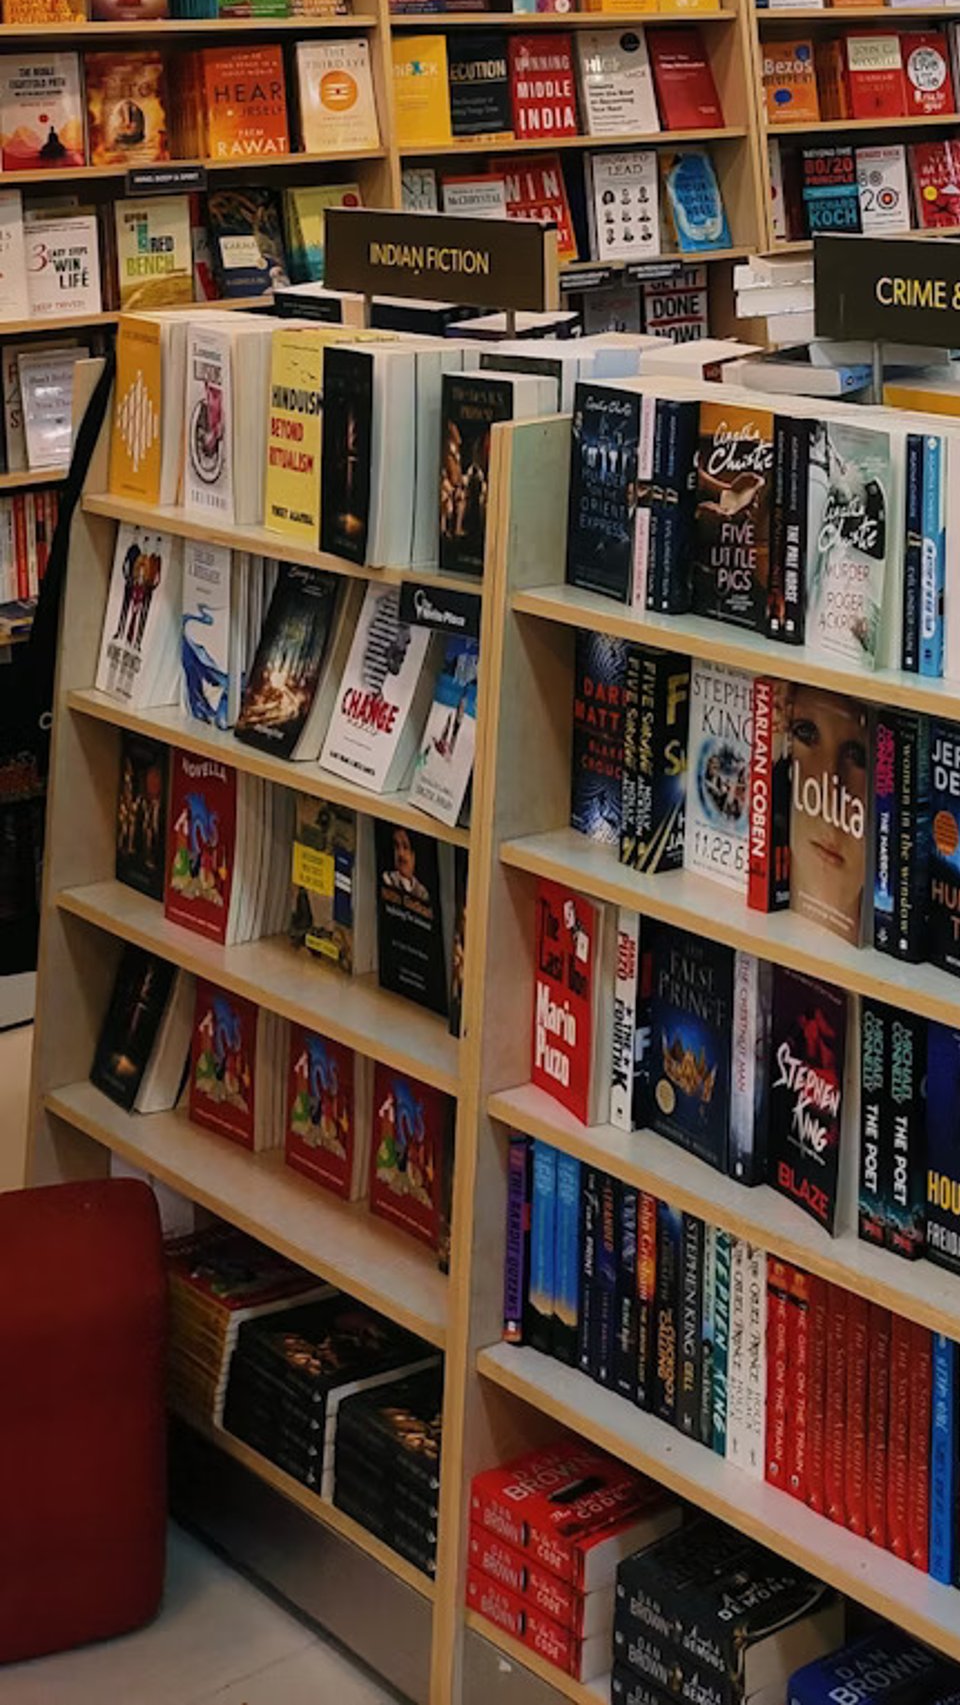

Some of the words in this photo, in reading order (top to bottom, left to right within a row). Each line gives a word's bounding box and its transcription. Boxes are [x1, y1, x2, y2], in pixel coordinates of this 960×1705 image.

[763, 58, 812, 74] Bezos
[214, 81, 283, 104] HEAR
[517, 80, 572, 98] MIDDLE
[519, 107, 576, 131] INDIA
[217, 137, 287, 157] RAWAT
[607, 164, 644, 177] LEAD
[804, 158, 854, 175] 80/20
[808, 209, 858, 227] KOCH
[53, 258, 82, 273] WIN
[126, 255, 175, 277] BENCH
[370, 243, 422, 270] INDIAN
[427, 248, 489, 275] FICTION
[59, 272, 89, 289] LIFE
[876, 277, 948, 310] CRIME
[652, 296, 699, 317] DONE
[270, 418, 304, 442] BEYOND
[713, 421, 764, 447] Agatha
[269, 445, 315, 475] RITUALISM
[708, 441, 774, 476] Christie
[722, 523, 755, 546] FIVE
[711, 546, 756, 569] LITTLE
[717, 568, 753, 592] PIGS
[341, 687, 400, 735] CHANGE
[753, 682, 772, 774] HARLAN
[182, 757, 227, 783] NOVELLA
[792, 758, 865, 841] lolita
[750, 778, 769, 859] COBEN
[535, 981, 577, 1047] Mario
[535, 1027, 571, 1088] Puzo
[773, 1042, 841, 1118] STEPHEN
[795, 1097, 829, 1153] KING
[866, 1104, 880, 1138] THE
[894, 1116, 909, 1151] THE
[864, 1143, 879, 1194] POET
[893, 1155, 908, 1207] POET
[777, 1160, 829, 1219] BLAZE
[684, 1217, 699, 1308] STEPHEN
[683, 1310, 697, 1357] KING
[502, 1452, 598, 1503] BROWN
